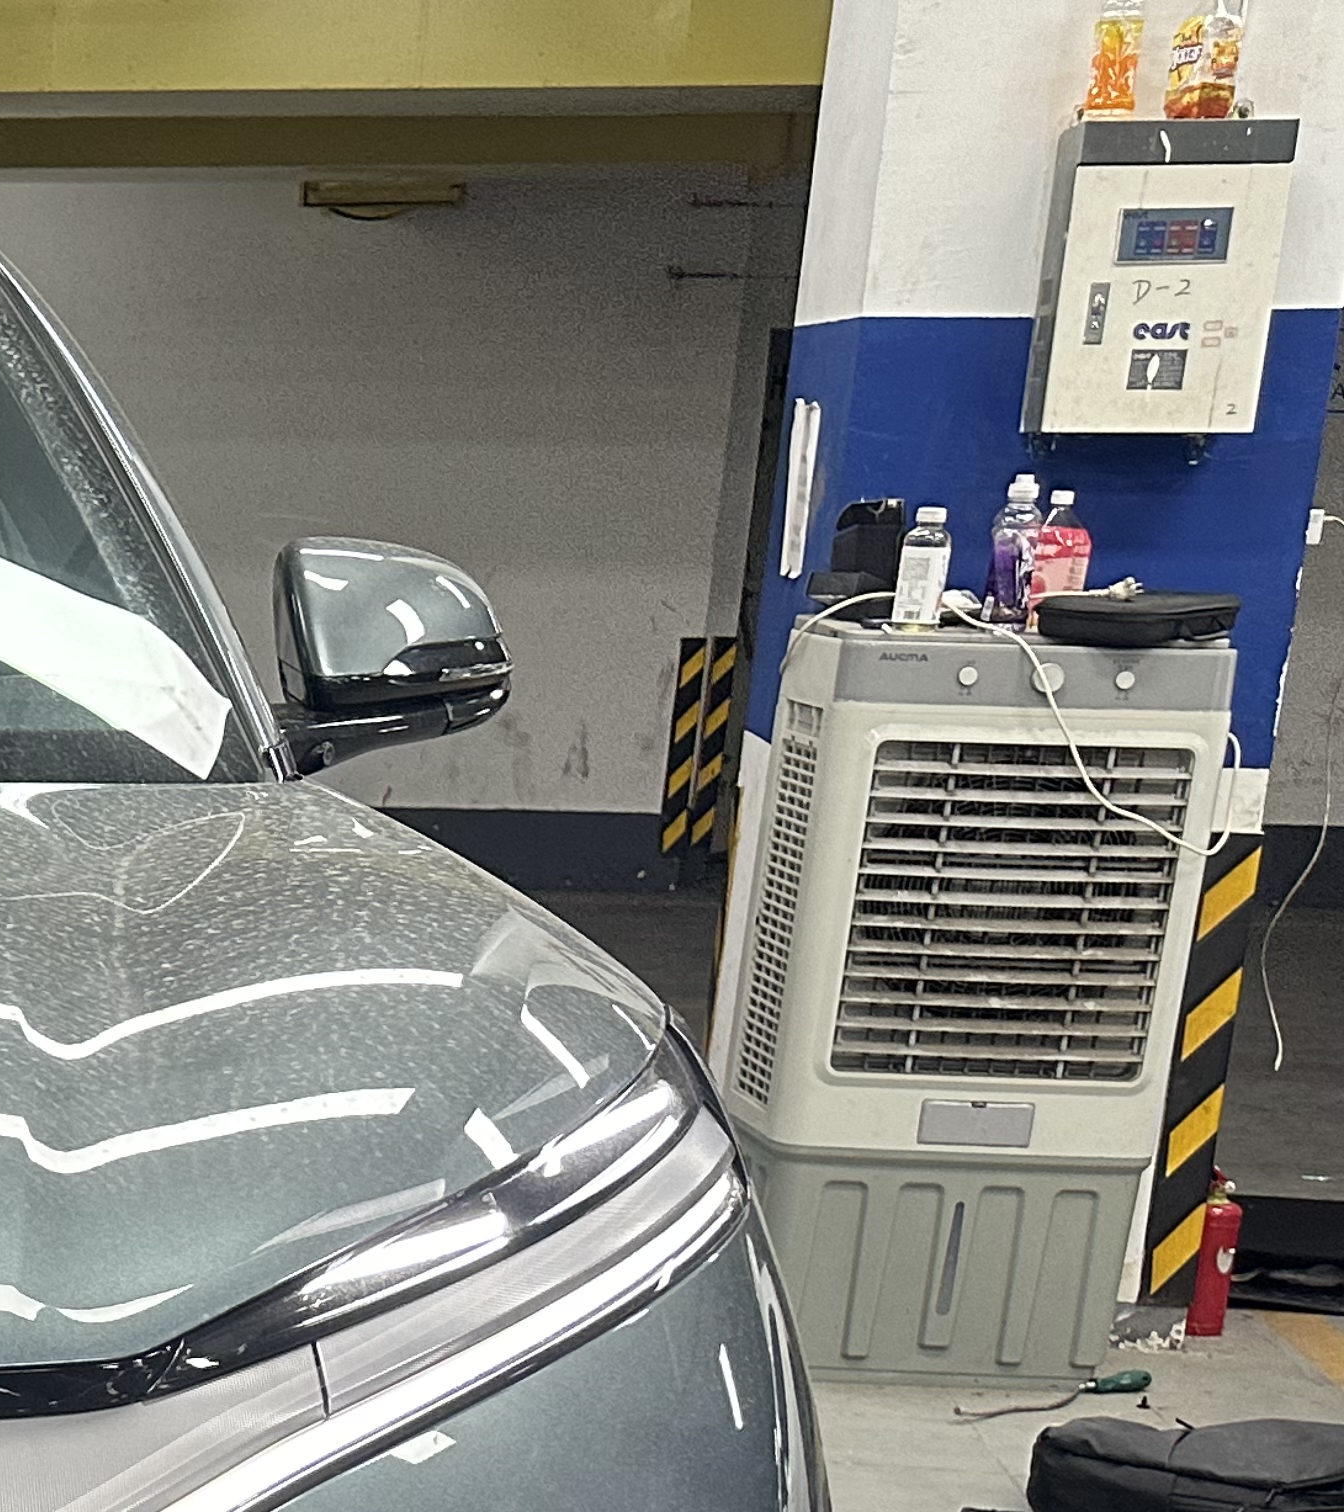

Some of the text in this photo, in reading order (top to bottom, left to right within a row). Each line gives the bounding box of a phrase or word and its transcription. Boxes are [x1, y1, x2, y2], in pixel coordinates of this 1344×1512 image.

[1132, 279, 1191, 305] D-2
[1133, 322, 1190, 340] east
[880, 652, 929, 662] AUCMA
